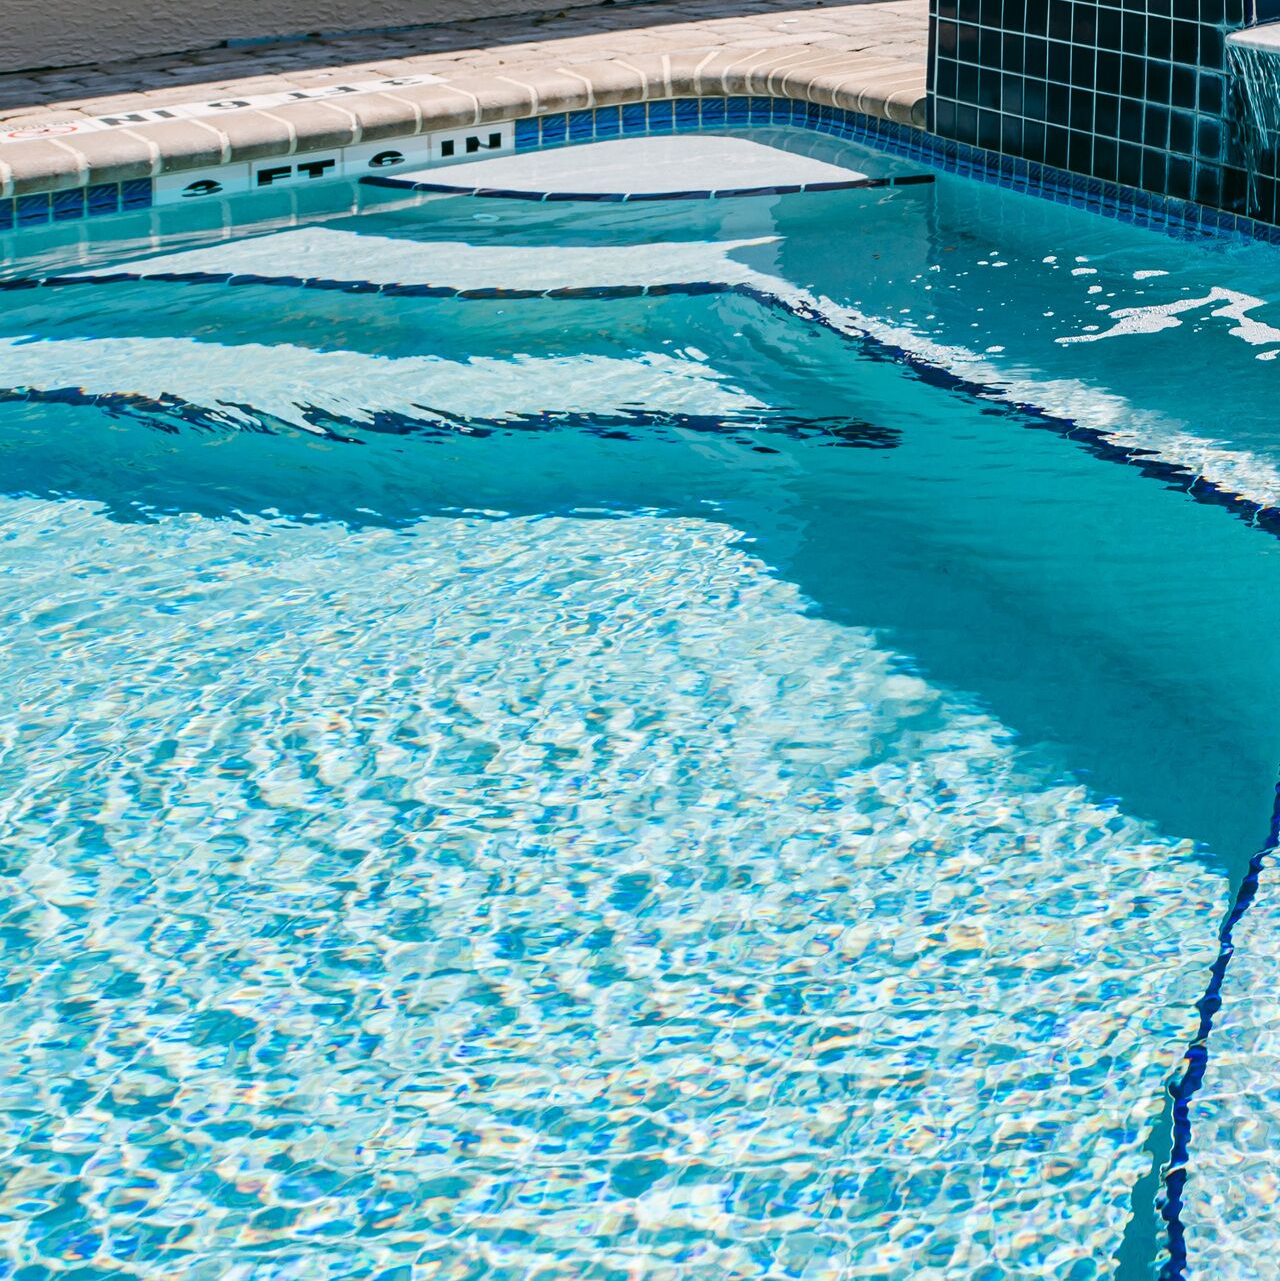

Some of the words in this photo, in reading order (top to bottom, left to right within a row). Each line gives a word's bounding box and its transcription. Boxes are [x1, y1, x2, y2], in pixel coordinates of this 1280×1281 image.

[208, 99, 251, 110] 6
[97, 110, 176, 127] IN
[181, 179, 224, 198] 3
[257, 159, 335, 186] FT
[368, 150, 406, 167] 6
[441, 132, 502, 157] IN
